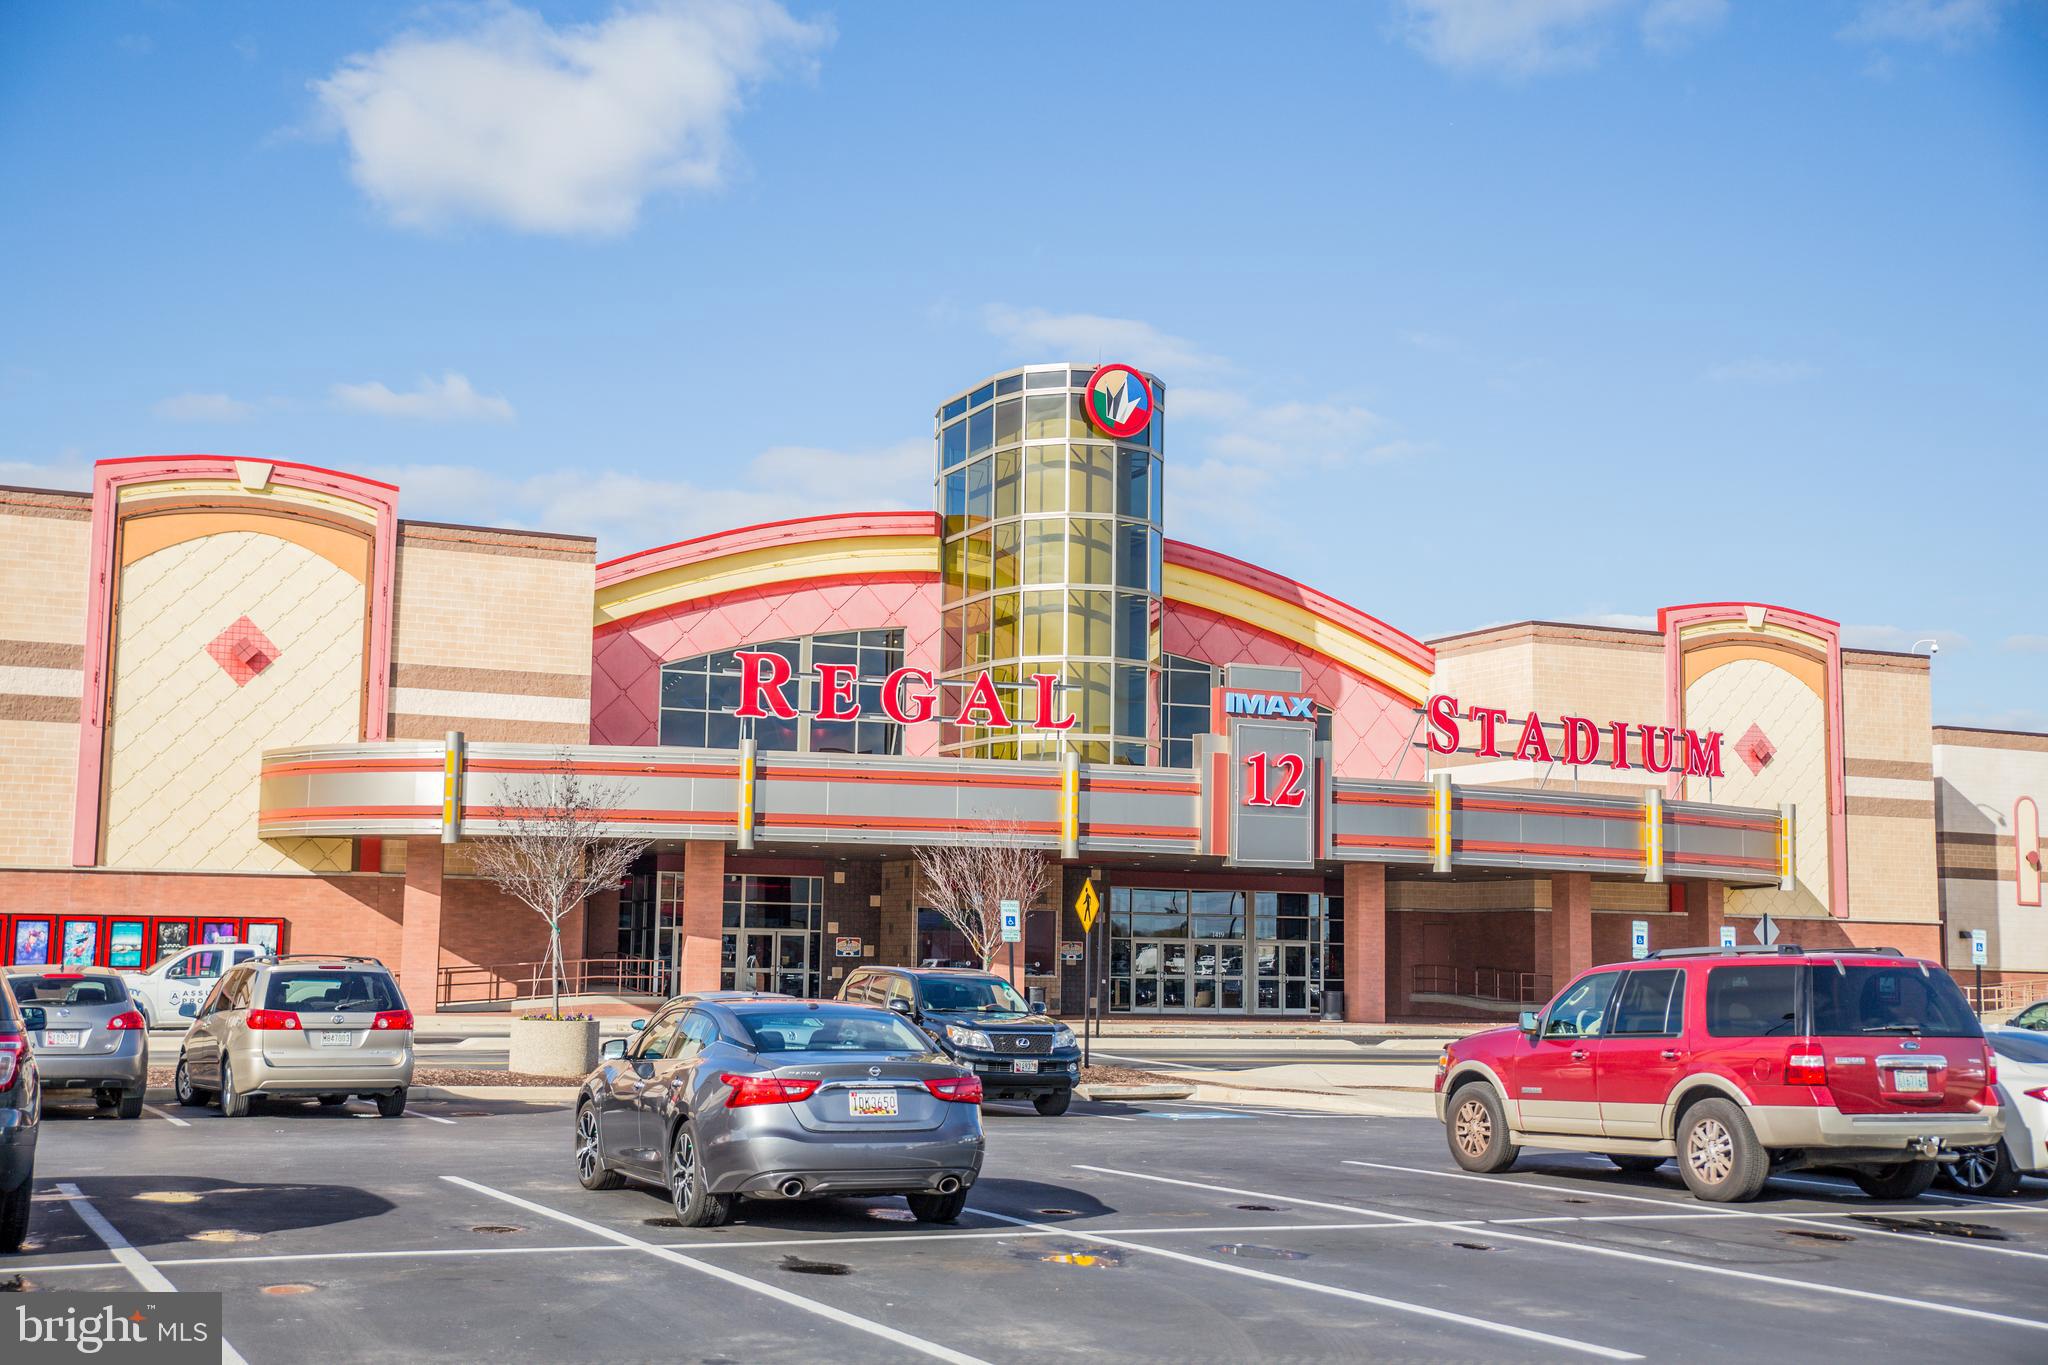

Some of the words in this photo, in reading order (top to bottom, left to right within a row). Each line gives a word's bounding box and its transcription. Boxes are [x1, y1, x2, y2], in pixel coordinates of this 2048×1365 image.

[734, 650, 1077, 731] REGAL
[1225, 691, 1314, 719] IMAX
[1426, 694, 1726, 778] STADIUM
[1246, 752, 1307, 808] 12
